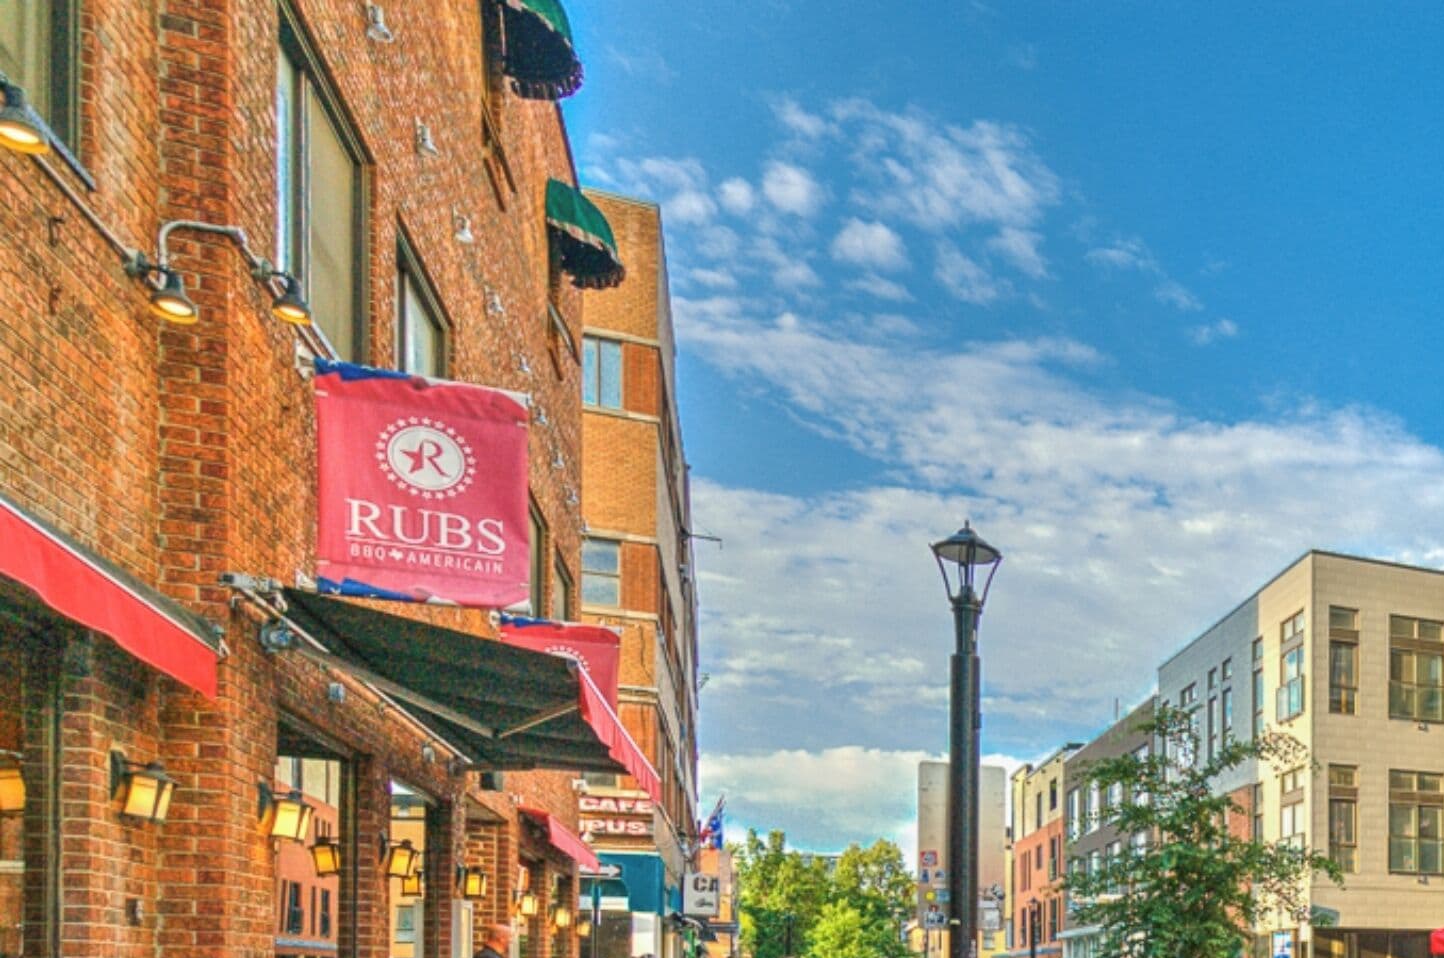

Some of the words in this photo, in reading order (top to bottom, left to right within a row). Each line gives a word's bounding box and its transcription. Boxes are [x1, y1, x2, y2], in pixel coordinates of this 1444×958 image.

[344, 498, 506, 555] RUBS
[350, 543, 387, 561] BBQ
[406, 551, 504, 575] AMERICAIN
